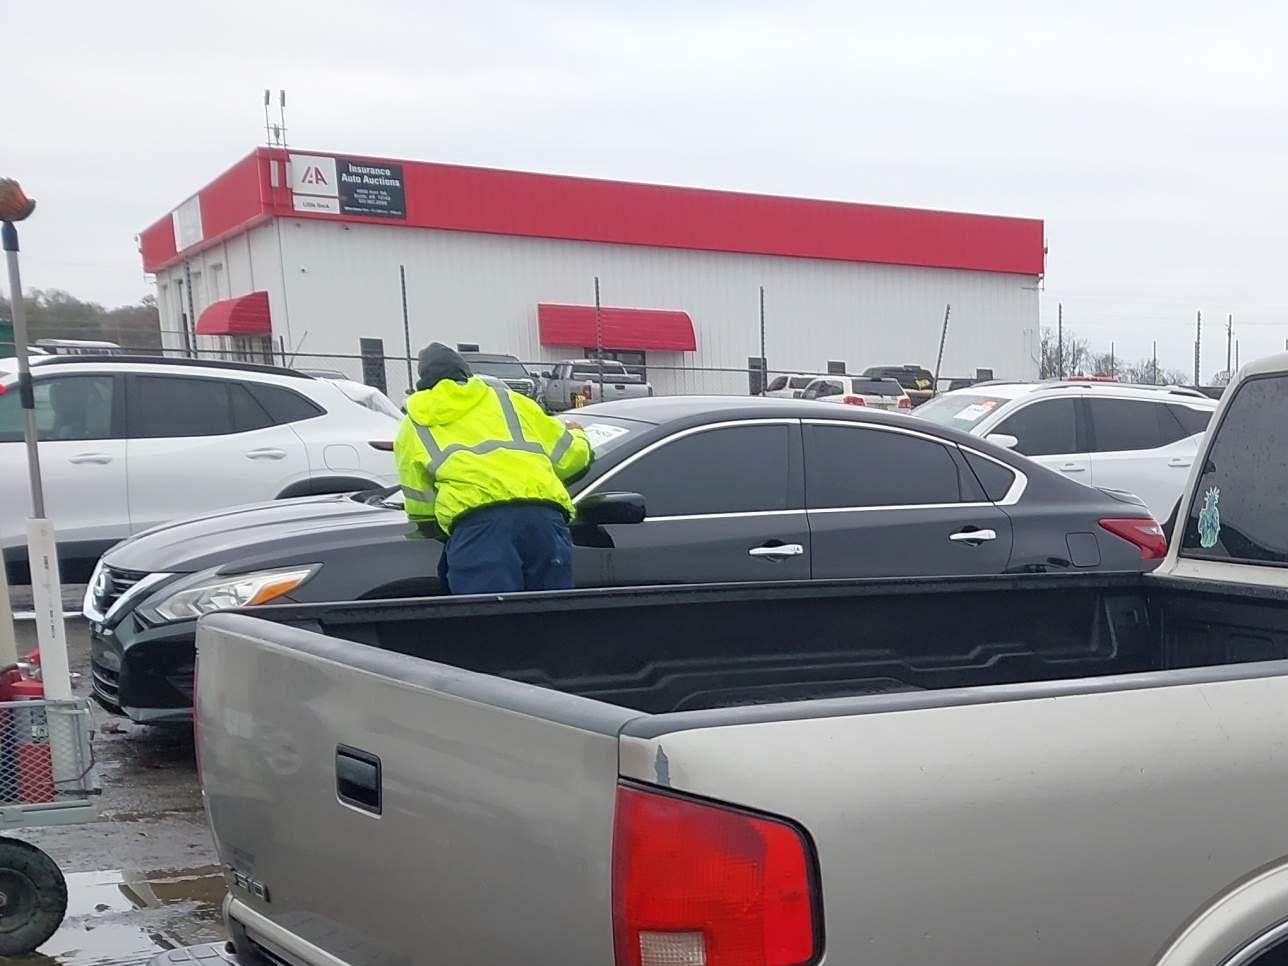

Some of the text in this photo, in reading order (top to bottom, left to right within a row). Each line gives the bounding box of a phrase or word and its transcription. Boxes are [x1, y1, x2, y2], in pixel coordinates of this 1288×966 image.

[348, 162, 391, 176] Insurance
[341, 172, 401, 187] Auto Auctions
